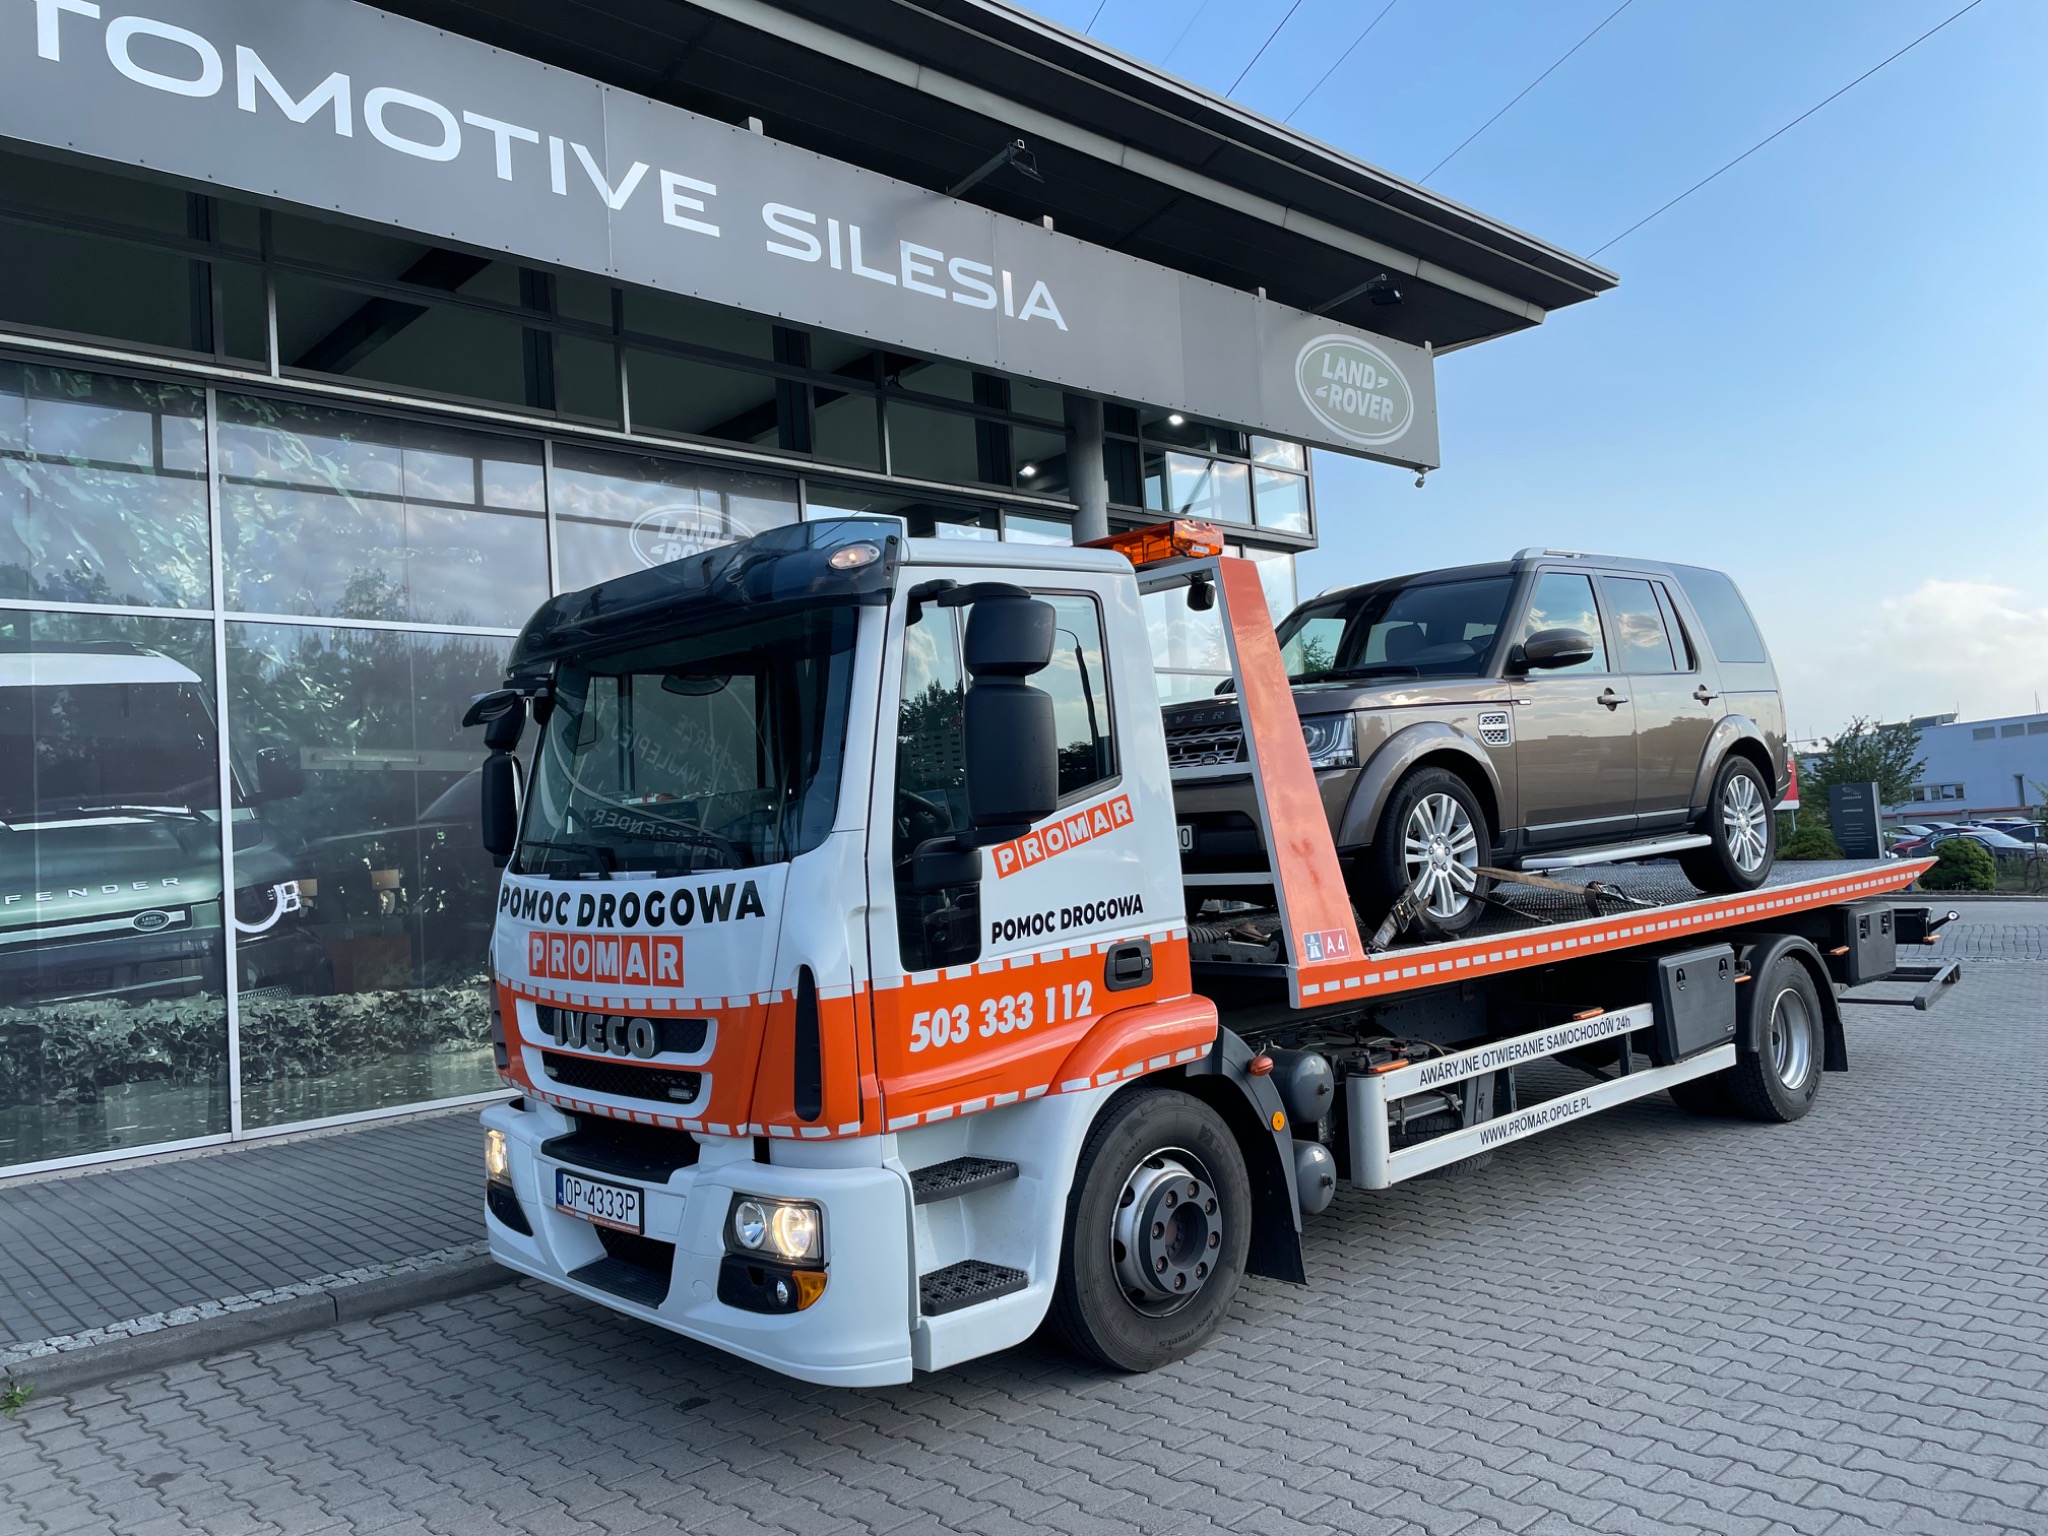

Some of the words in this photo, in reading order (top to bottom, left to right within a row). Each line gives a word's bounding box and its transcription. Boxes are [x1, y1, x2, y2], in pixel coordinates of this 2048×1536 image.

[761, 202, 1069, 331] SILESIA
[1321, 352, 1376, 390] LAND
[1328, 383, 1394, 423] ROVER
[657, 519, 721, 545] LAND
[998, 799, 1131, 873] PROMAR
[499, 884, 571, 926] POMOC
[576, 880, 766, 929] DROGOWA
[991, 911, 1056, 944] POMOC
[1060, 894, 1144, 931] DROGOWA
[531, 937, 680, 981] PROMAR
[552, 1009, 661, 1059] IVECO
[909, 1004, 970, 1053] 503
[979, 991, 1034, 1038] 333
[1045, 980, 1093, 1024] 112
[1482, 1037, 1545, 1069] OTWIERANIE
[1546, 1017, 1614, 1051] SAMOCHODÓW
[1615, 1014, 1632, 1031] 24h
[1479, 1096, 1592, 1146] WWW.PROMAR.OPOLE.PL
